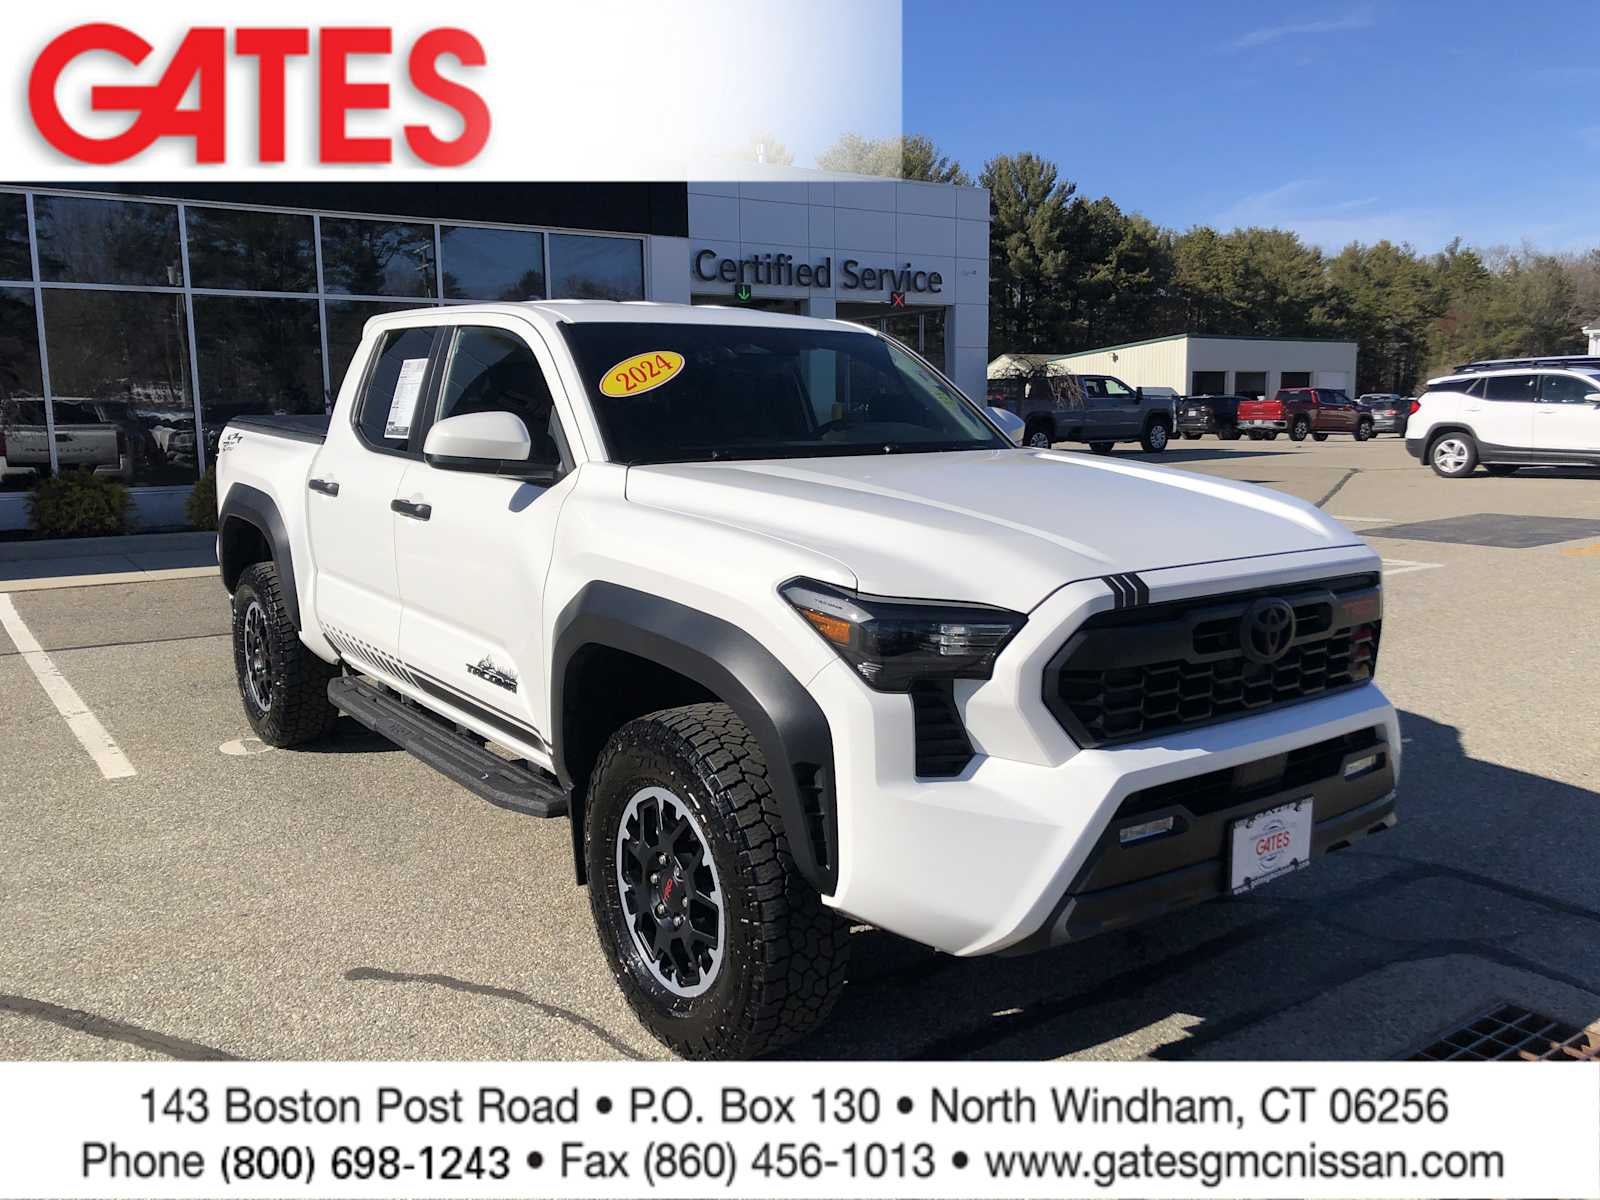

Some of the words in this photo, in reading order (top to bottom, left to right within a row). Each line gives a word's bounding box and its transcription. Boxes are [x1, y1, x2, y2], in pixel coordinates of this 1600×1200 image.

[695, 249, 831, 289] Certified
[842, 259, 942, 293] Service
[616, 355, 672, 391] 2024
[1255, 831, 1290, 855] GATES
